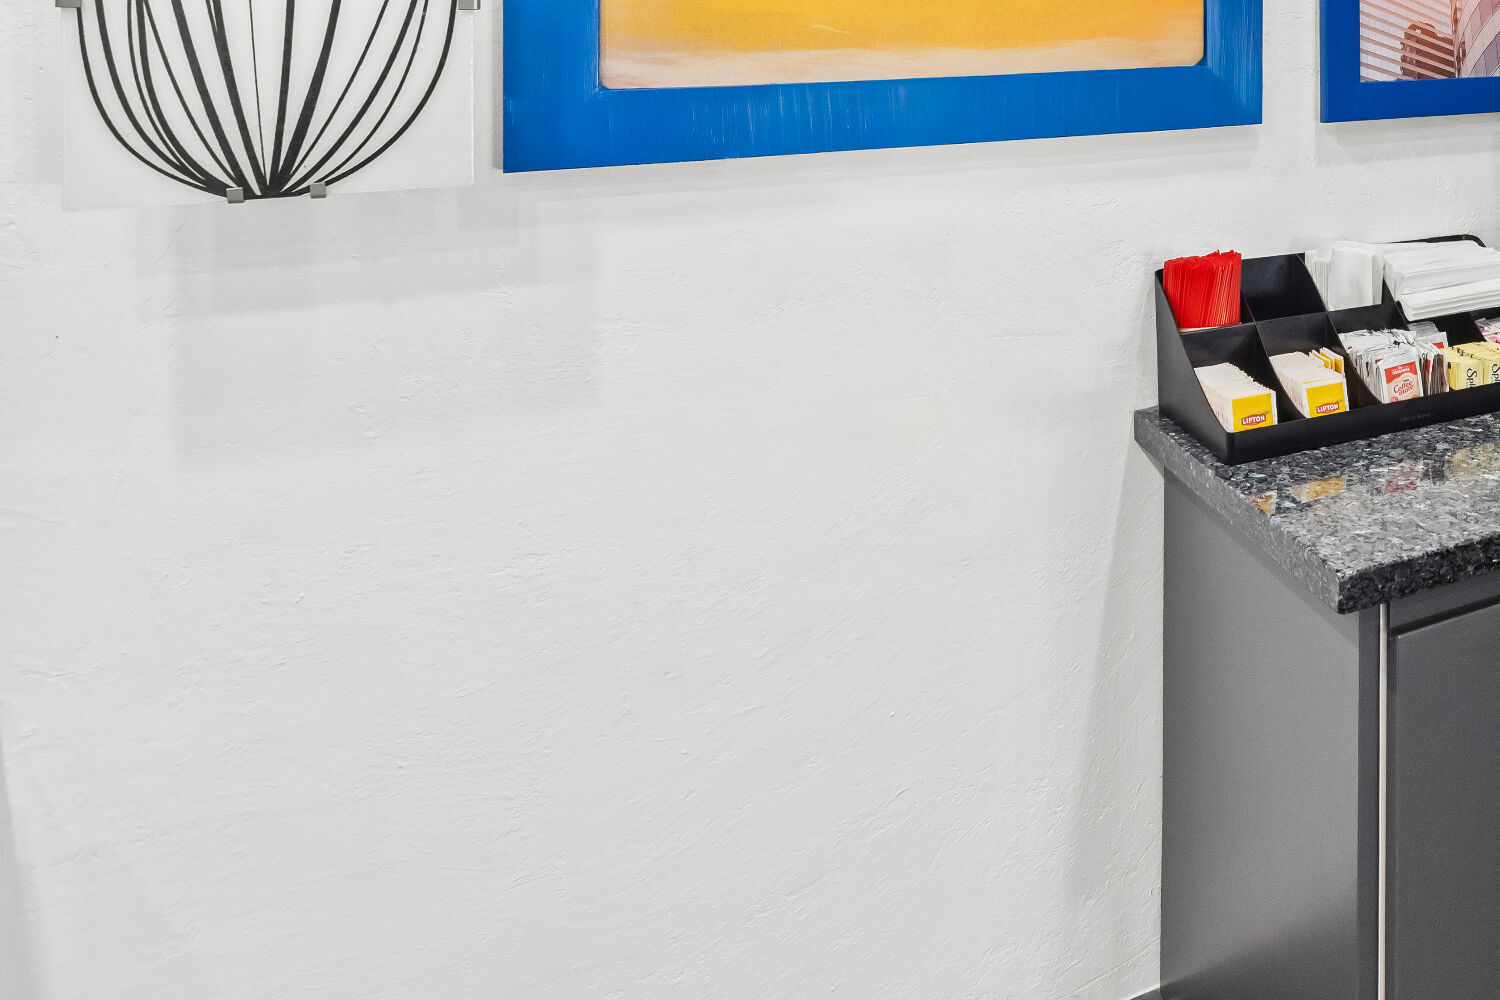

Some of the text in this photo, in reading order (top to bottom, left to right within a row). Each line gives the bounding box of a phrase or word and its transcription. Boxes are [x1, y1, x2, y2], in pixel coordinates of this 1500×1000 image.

[1466, 368, 1478, 388] Spl
[1393, 380, 1413, 394] Coffee
[1317, 403, 1339, 413] LIPTON
[1242, 415, 1266, 425] LIPTON
